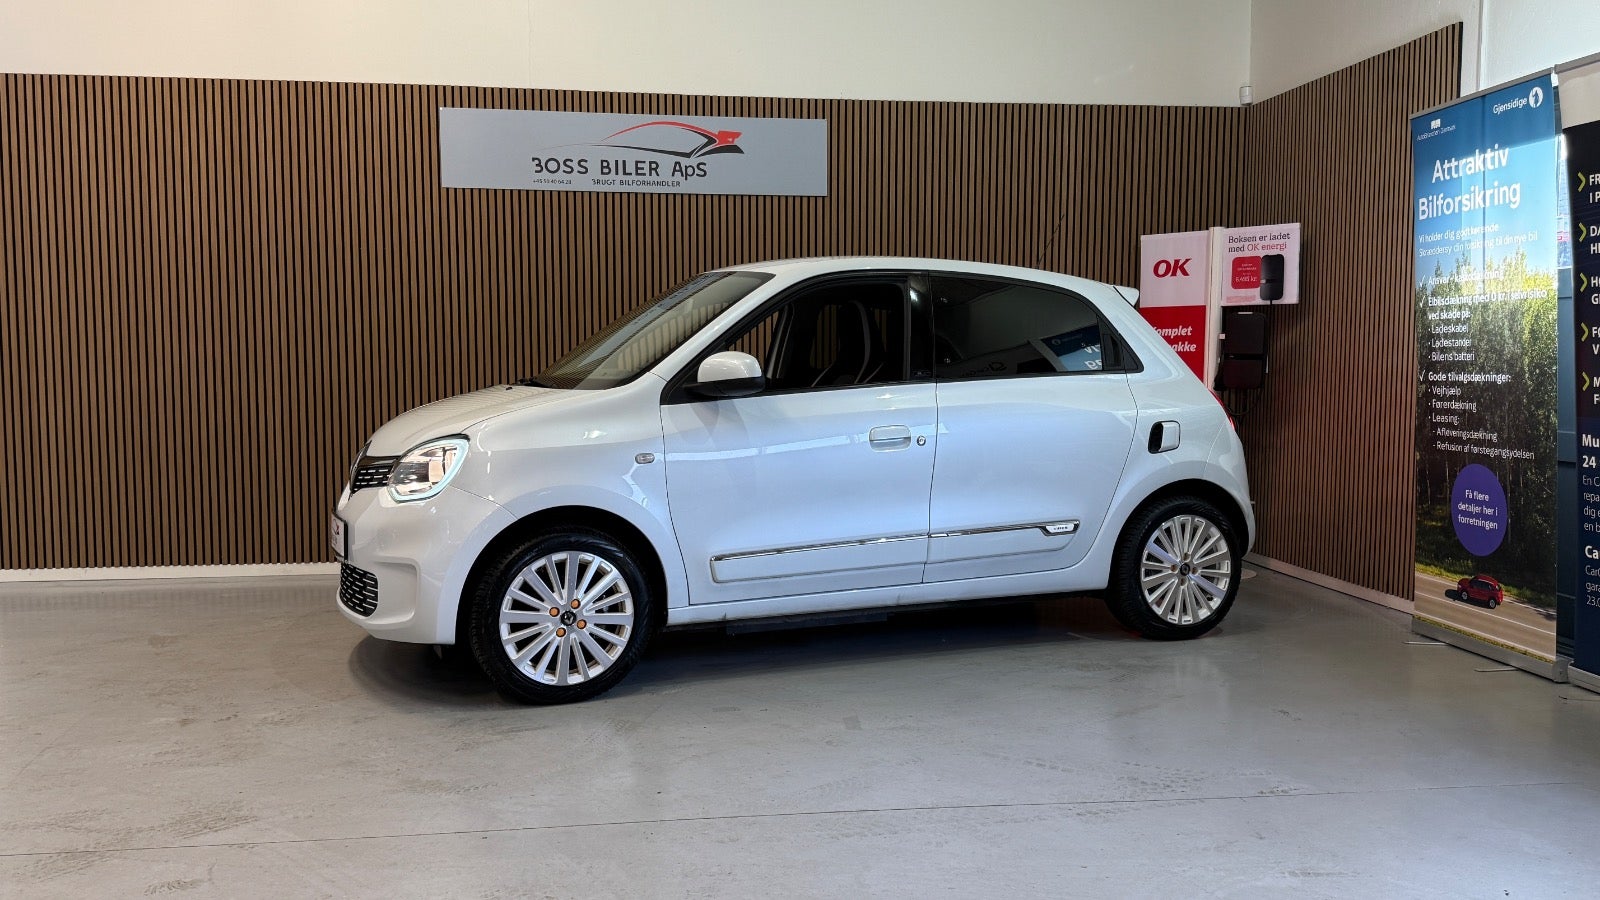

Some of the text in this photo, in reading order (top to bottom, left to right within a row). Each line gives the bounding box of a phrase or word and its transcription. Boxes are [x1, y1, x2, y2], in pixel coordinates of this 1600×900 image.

[1493, 97, 1528, 114] Gjensidige
[532, 157, 707, 180] BOSS BILER ApS
[1432, 144, 1509, 183] Attraktiv
[1418, 181, 1521, 220] Bilforsikring
[1228, 235, 1257, 244] Boksen
[1269, 232, 1290, 241] ladet
[1419, 234, 1425, 243] Vi
[1425, 232, 1442, 242] holder
[1444, 230, 1455, 240] dig
[1454, 243, 1464, 252] din
[1513, 234, 1526, 245] nye
[1528, 230, 1538, 241] bil
[1261, 242, 1287, 251] energi
[1153, 258, 1192, 278] OK
[1428, 294, 1472, 307] Elbilsdækning
[1474, 293, 1490, 303] med
[1428, 311, 1439, 320] ved
[1440, 310, 1460, 319] skade
[1432, 324, 1469, 334] Ladeskabel
[1432, 351, 1475, 361] Bilens batteri
[1429, 372, 1511, 384] Gode tilvalgsdækninger:
[1432, 386, 1461, 397] Vejhjælp
[1432, 399, 1476, 412] Førerdækning
[1432, 413, 1460, 425] Leasing:
[1437, 428, 1497, 442] Afleveringsdækning
[1437, 441, 1534, 460] Refusion af førstegangsydelsen
[1582, 455, 1597, 468] 24
[1583, 474, 1592, 486] En
[1466, 489, 1489, 502] Få flere
[1458, 502, 1482, 514] detaljer
[1483, 505, 1494, 515] her
[1584, 505, 1596, 519] dig
[1458, 515, 1498, 530] forretningen
[1584, 522, 1594, 531] en
